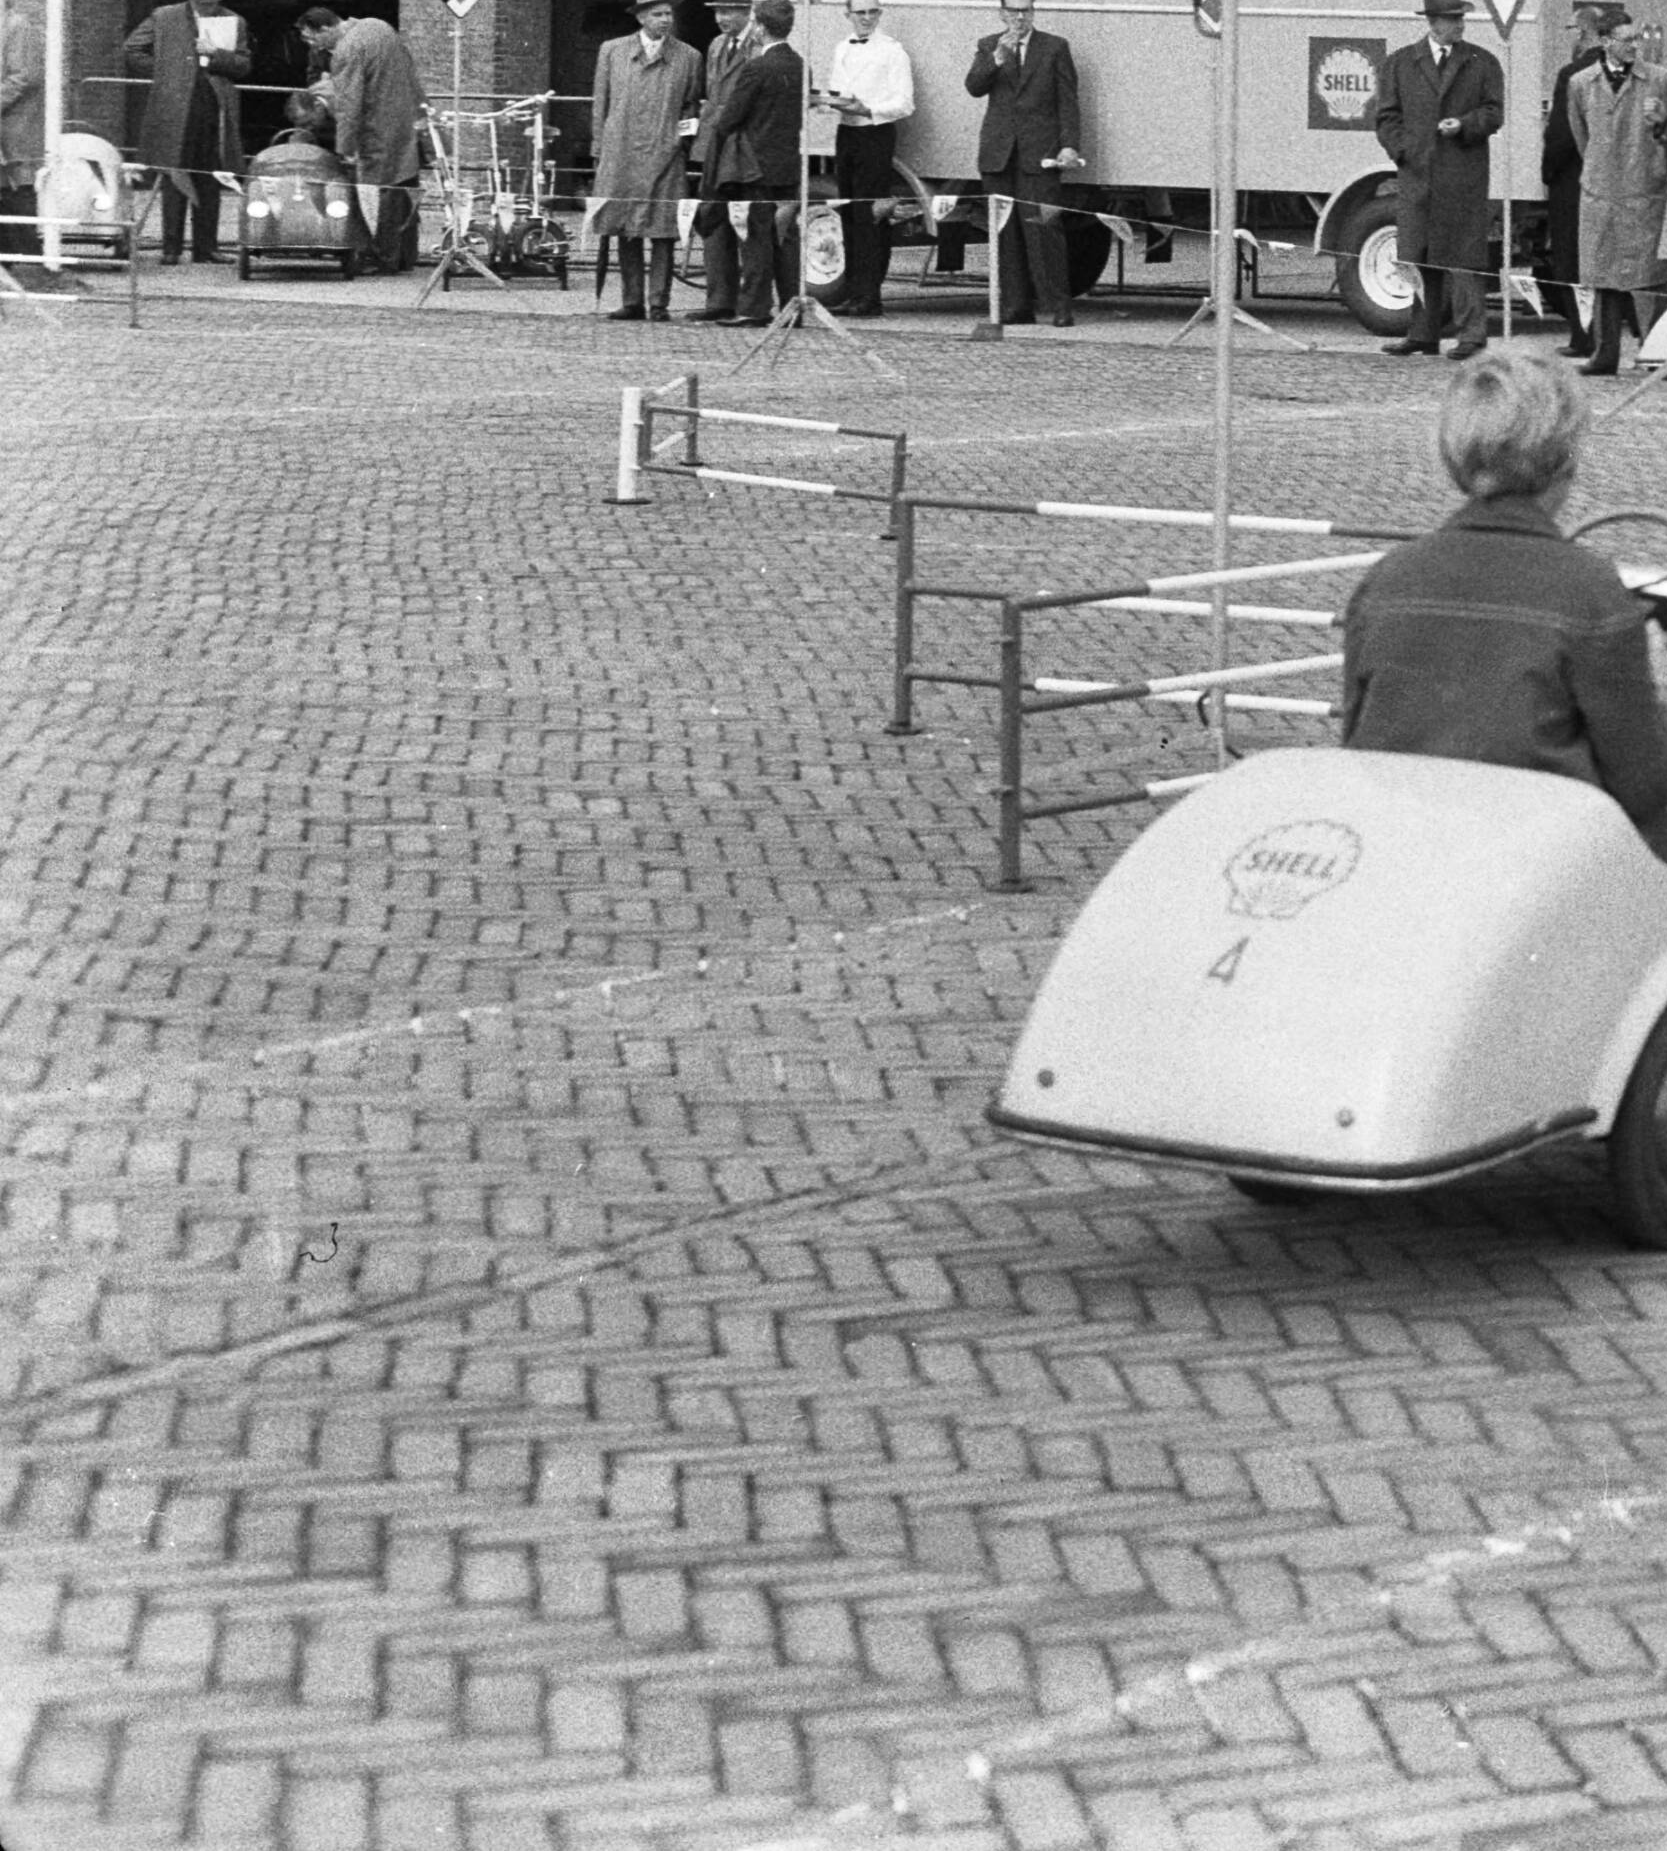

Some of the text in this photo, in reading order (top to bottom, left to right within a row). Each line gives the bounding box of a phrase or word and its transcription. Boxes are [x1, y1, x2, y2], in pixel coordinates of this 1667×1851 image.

[1323, 73, 1372, 93] SHELL
[1245, 849, 1338, 880] SHELL
[1207, 936, 1250, 984] 4
